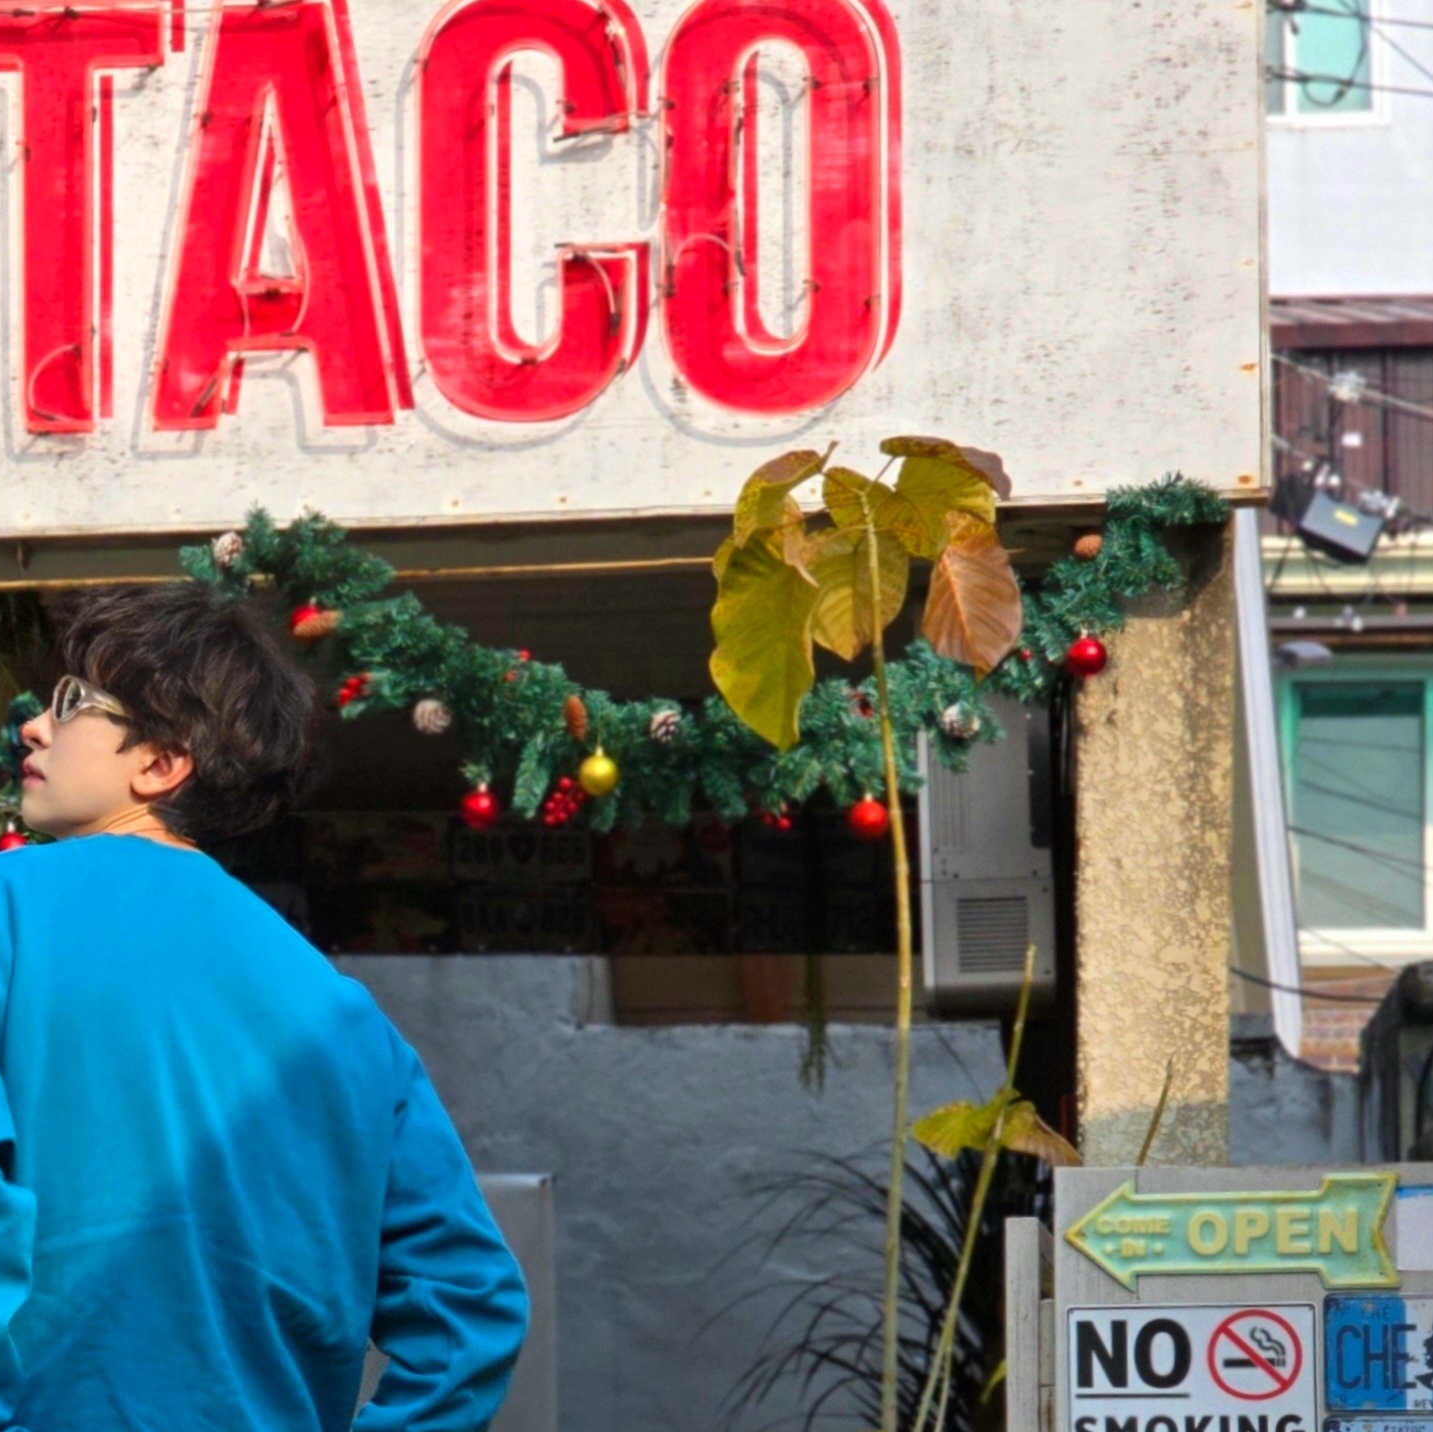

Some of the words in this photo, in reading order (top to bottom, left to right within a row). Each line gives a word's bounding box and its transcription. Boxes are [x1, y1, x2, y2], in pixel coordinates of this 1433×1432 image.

[1096, 1217, 1169, 1235] COME
[1120, 1239, 1147, 1257] IN
[1186, 1205, 1361, 1257] OPEN
[1075, 1317, 1192, 1389] NO
[1336, 1324, 1418, 1390] CHE
